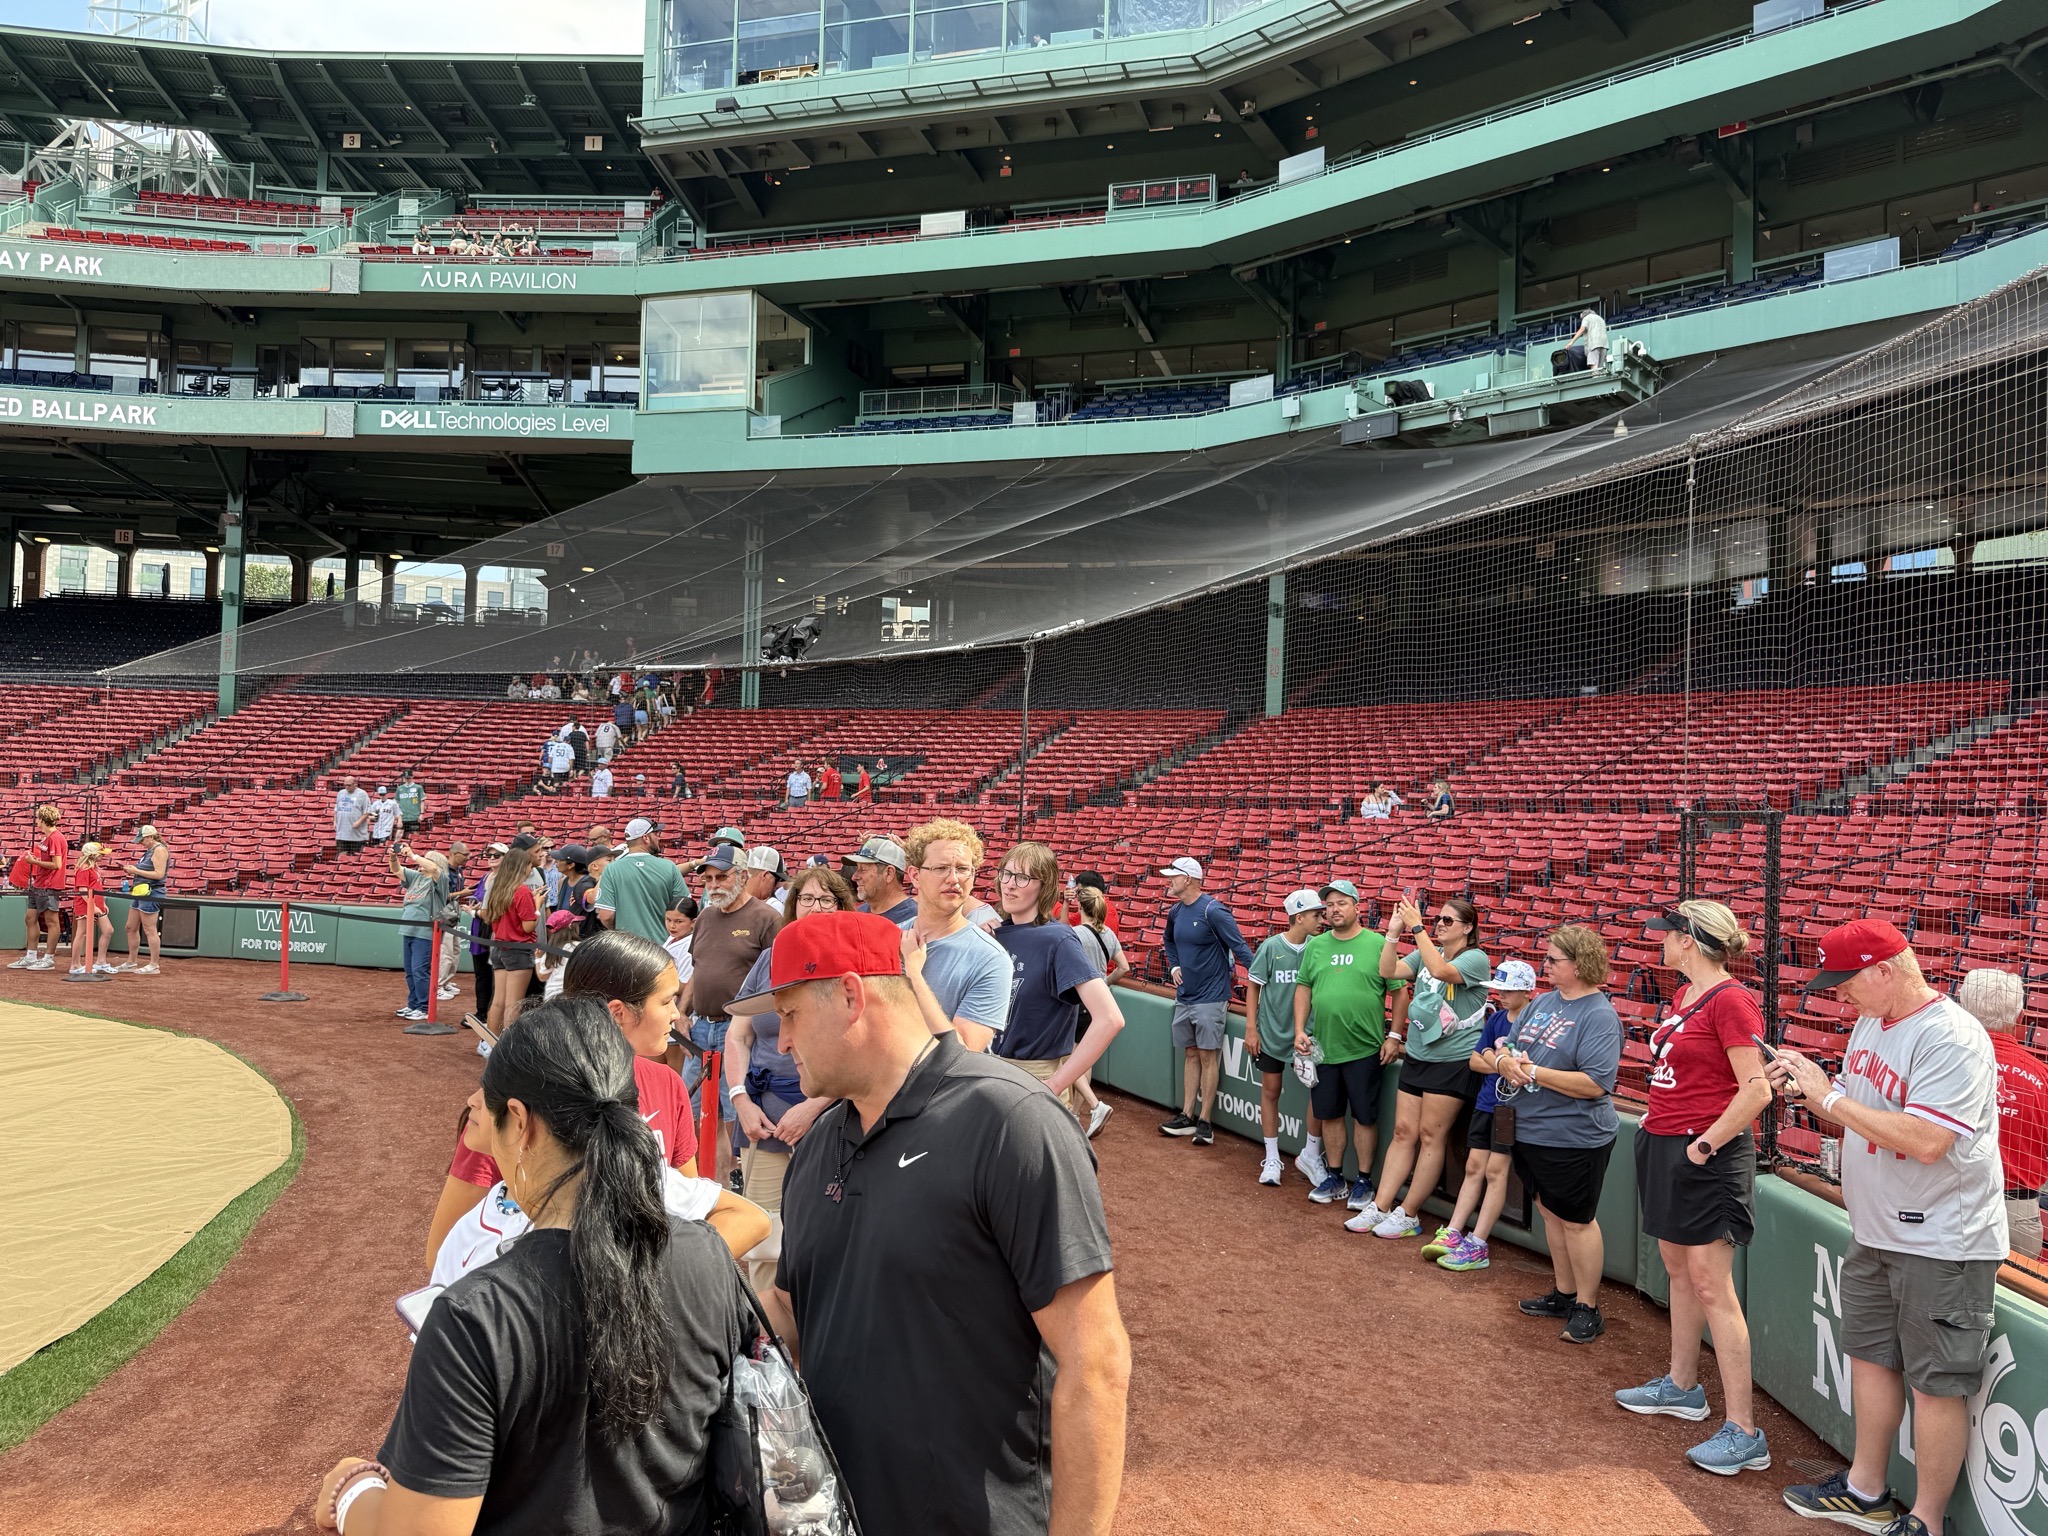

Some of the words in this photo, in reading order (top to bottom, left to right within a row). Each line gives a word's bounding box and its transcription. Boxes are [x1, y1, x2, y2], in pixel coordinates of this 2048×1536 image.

[348, 135, 356, 147] 3
[0, 250, 31, 271] AY
[39, 253, 104, 276] PARK
[489, 271, 577, 289] PAVILION
[31, 399, 158, 426] BALLPARK
[380, 409, 437, 430] DELL
[437, 410, 556, 435] Technologies
[561, 413, 610, 433] Level
[119, 531, 130, 542] 16
[550, 545, 561, 556] 17
[555, 748, 566, 757] 50
[720, 828, 727, 837] B
[256, 909, 316, 934] WM
[241, 938, 263, 950] FOR
[1330, 954, 1354, 966] 310
[1518, 1010, 1577, 1050] LOVE
[2011, 1066, 2045, 1091] PARK
[1216, 1090, 1301, 1139] TOMOROW
